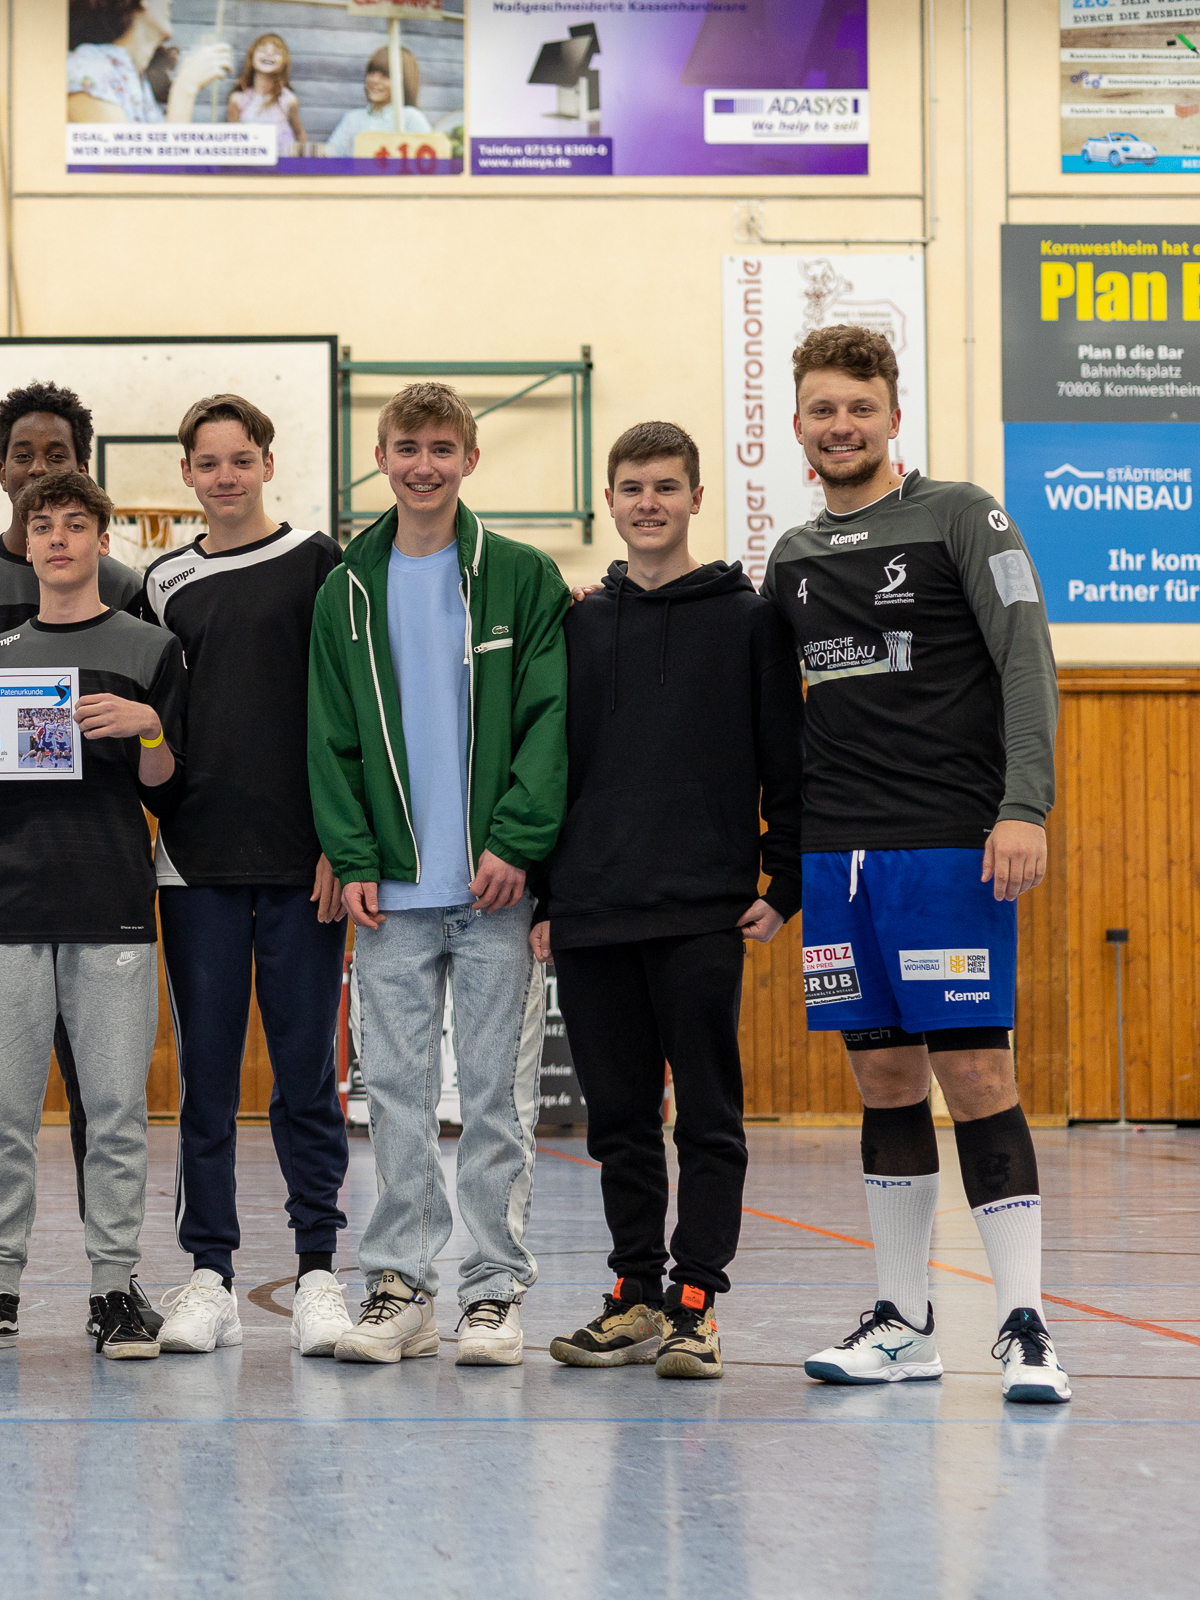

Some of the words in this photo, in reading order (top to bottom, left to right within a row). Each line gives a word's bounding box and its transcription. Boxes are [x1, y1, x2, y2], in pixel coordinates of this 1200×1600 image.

[1073, 13, 1114, 23] DURCH
[1119, 11, 1140, 20] DIE
[767, 98, 848, 115] ADASYS
[72, 133, 109, 143] EGAL,
[114, 133, 142, 142] WAS
[147, 133, 168, 142] SIE
[173, 133, 249, 142] VERKAUFEN
[72, 147, 99, 156] WIR
[104, 147, 153, 156] HELFEN
[157, 147, 189, 156] BEIM
[194, 147, 268, 156] KASSIEREN
[478, 144, 523, 156] Telefon
[1041, 240, 1158, 255] Kornwestheim
[1162, 240, 1189, 255] hat
[1041, 261, 1167, 321] Plan
[1078, 345, 1112, 360] Plan
[1116, 345, 1127, 360] B
[1130, 345, 1154, 360] die
[1158, 345, 1184, 360] Bar
[737, 259, 765, 468] Gastronomie
[1080, 363, 1182, 381] Bahnhofsplatz
[1057, 381, 1100, 397] 70806
[1106, 466, 1191, 482] STÄDTISCHE
[1045, 485, 1192, 510] WOHNBAU
[743, 480, 774, 590] ninger
[830, 531, 868, 546] Kempa
[1109, 548, 1146, 571] Ihr
[158, 566, 196, 593] Kempa
[797, 578, 808, 604] 4
[882, 591, 914, 600] Salamander
[1068, 579, 1159, 602] Partner
[1164, 579, 1199, 602] für
[874, 598, 915, 606] Kornwestheim
[803, 636, 854, 655] STÄDTISCHE
[808, 645, 876, 668] WOHNBAU
[0, 688, 44, 697] Patenurkunde
[120, 951, 136, 961] NIKE
[944, 990, 990, 1004] Kempa
[863, 1178, 912, 1189] mpa
